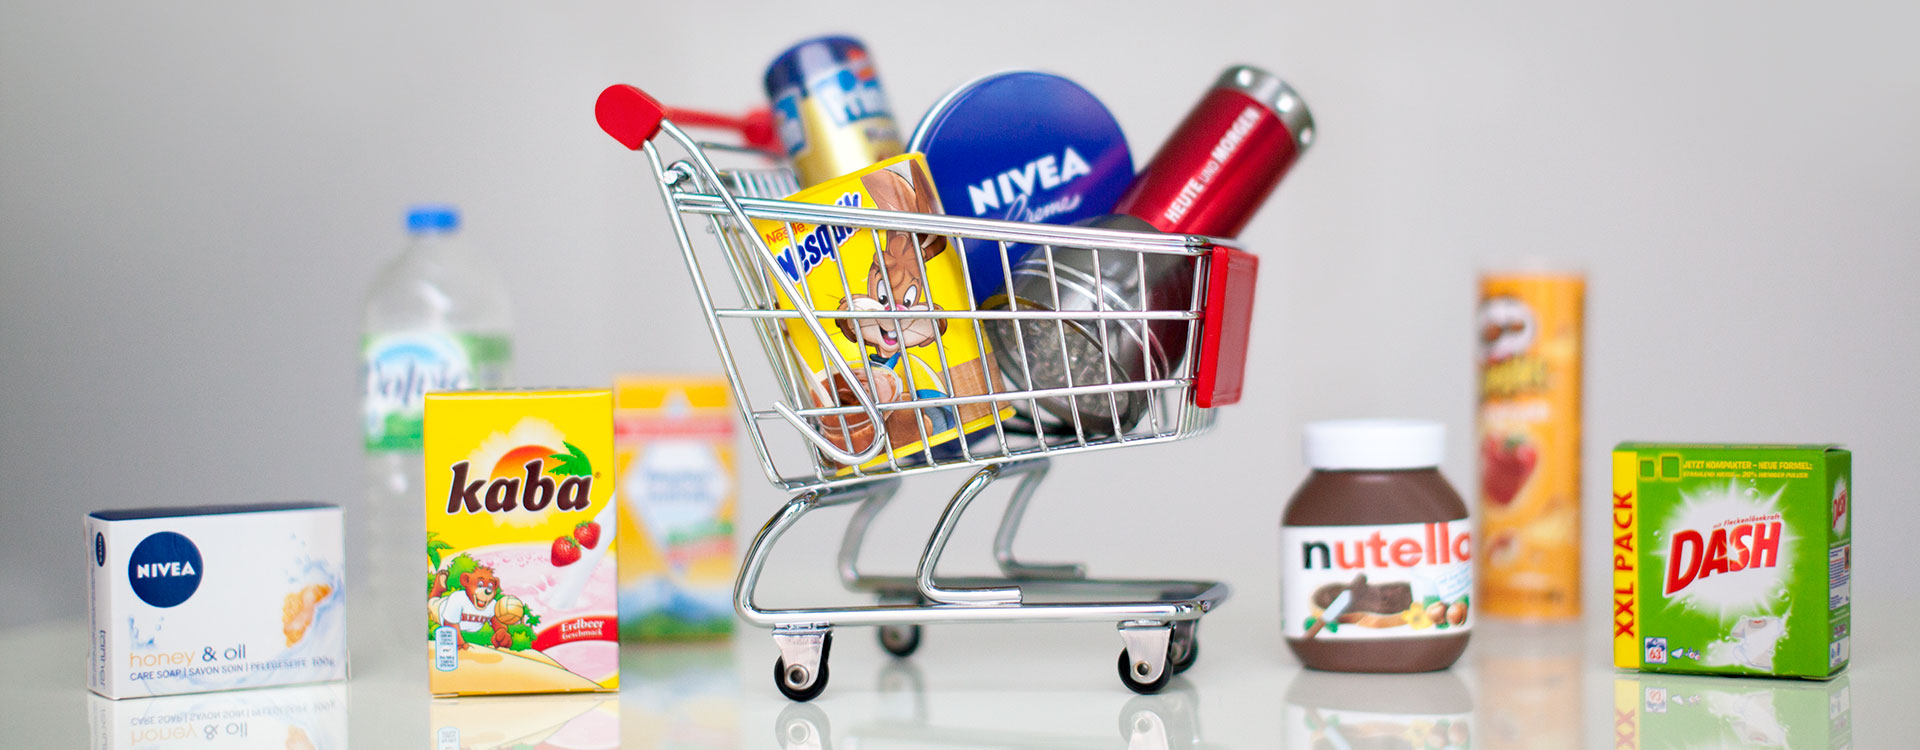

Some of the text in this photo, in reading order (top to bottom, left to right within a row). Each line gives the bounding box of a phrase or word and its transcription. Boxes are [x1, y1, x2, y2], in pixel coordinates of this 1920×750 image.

[967, 146, 1091, 216] NIVEA
[1164, 106, 1260, 224] HEUTE UND MORGEN
[1683, 460, 1704, 469] JETZT
[1706, 461, 1752, 469] KOMPAKTER
[1759, 462, 1778, 470] NEUE
[446, 460, 593, 514] kaba
[1302, 521, 1471, 570] nutella
[1613, 490, 1635, 638] XXL PACK
[1664, 521, 1782, 599] DASH
[137, 561, 196, 579] NIVEA
[562, 619, 605, 632] Erdbeer
[562, 630, 603, 640] Geschmack
[129, 643, 246, 668] honey & oil
[130, 671, 154, 681] CARE
[156, 669, 182, 679] SOAP
[188, 665, 219, 676] SAVON
[221, 664, 244, 673] SOIN
